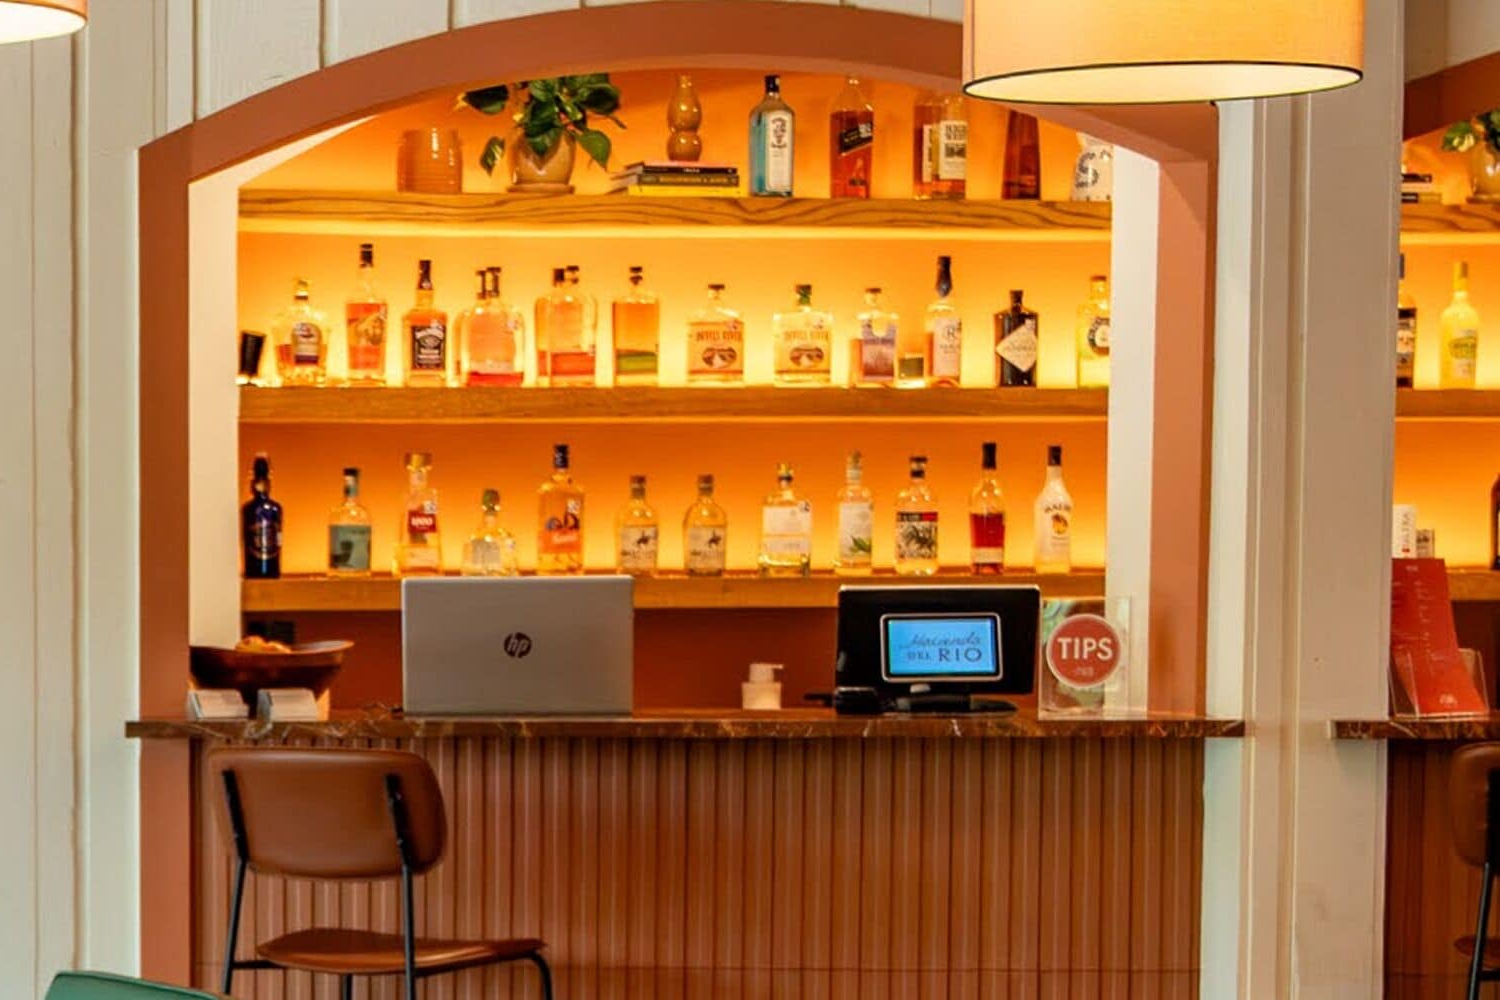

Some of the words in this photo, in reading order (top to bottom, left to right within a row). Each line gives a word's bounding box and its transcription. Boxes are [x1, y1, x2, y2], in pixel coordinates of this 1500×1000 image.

[505, 632, 531, 659] hp
[938, 647, 982, 662] RIO
[1057, 637, 1113, 661] TIPS
